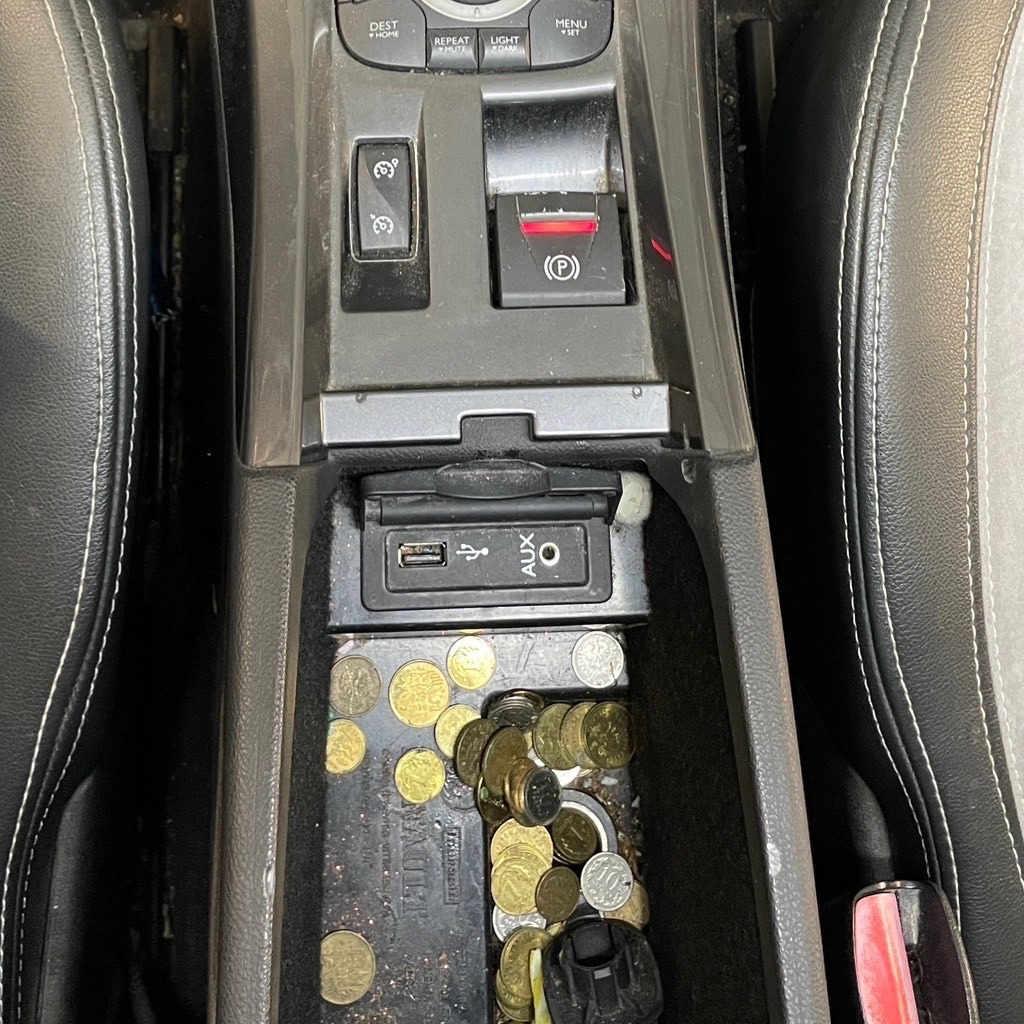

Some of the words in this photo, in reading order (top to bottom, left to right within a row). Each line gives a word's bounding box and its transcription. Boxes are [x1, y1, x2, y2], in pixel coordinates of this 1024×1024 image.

[370, 21, 398, 31] DEST
[555, 19, 588, 30] MENU
[376, 30, 399, 38] HOME
[434, 36, 470, 46] REPEAT
[490, 36, 520, 45] LIGHT
[445, 45, 466, 53] MUTE
[557, 260, 568, 275] P
[519, 533, 536, 577] AUX
[597, 866, 620, 890] 10
